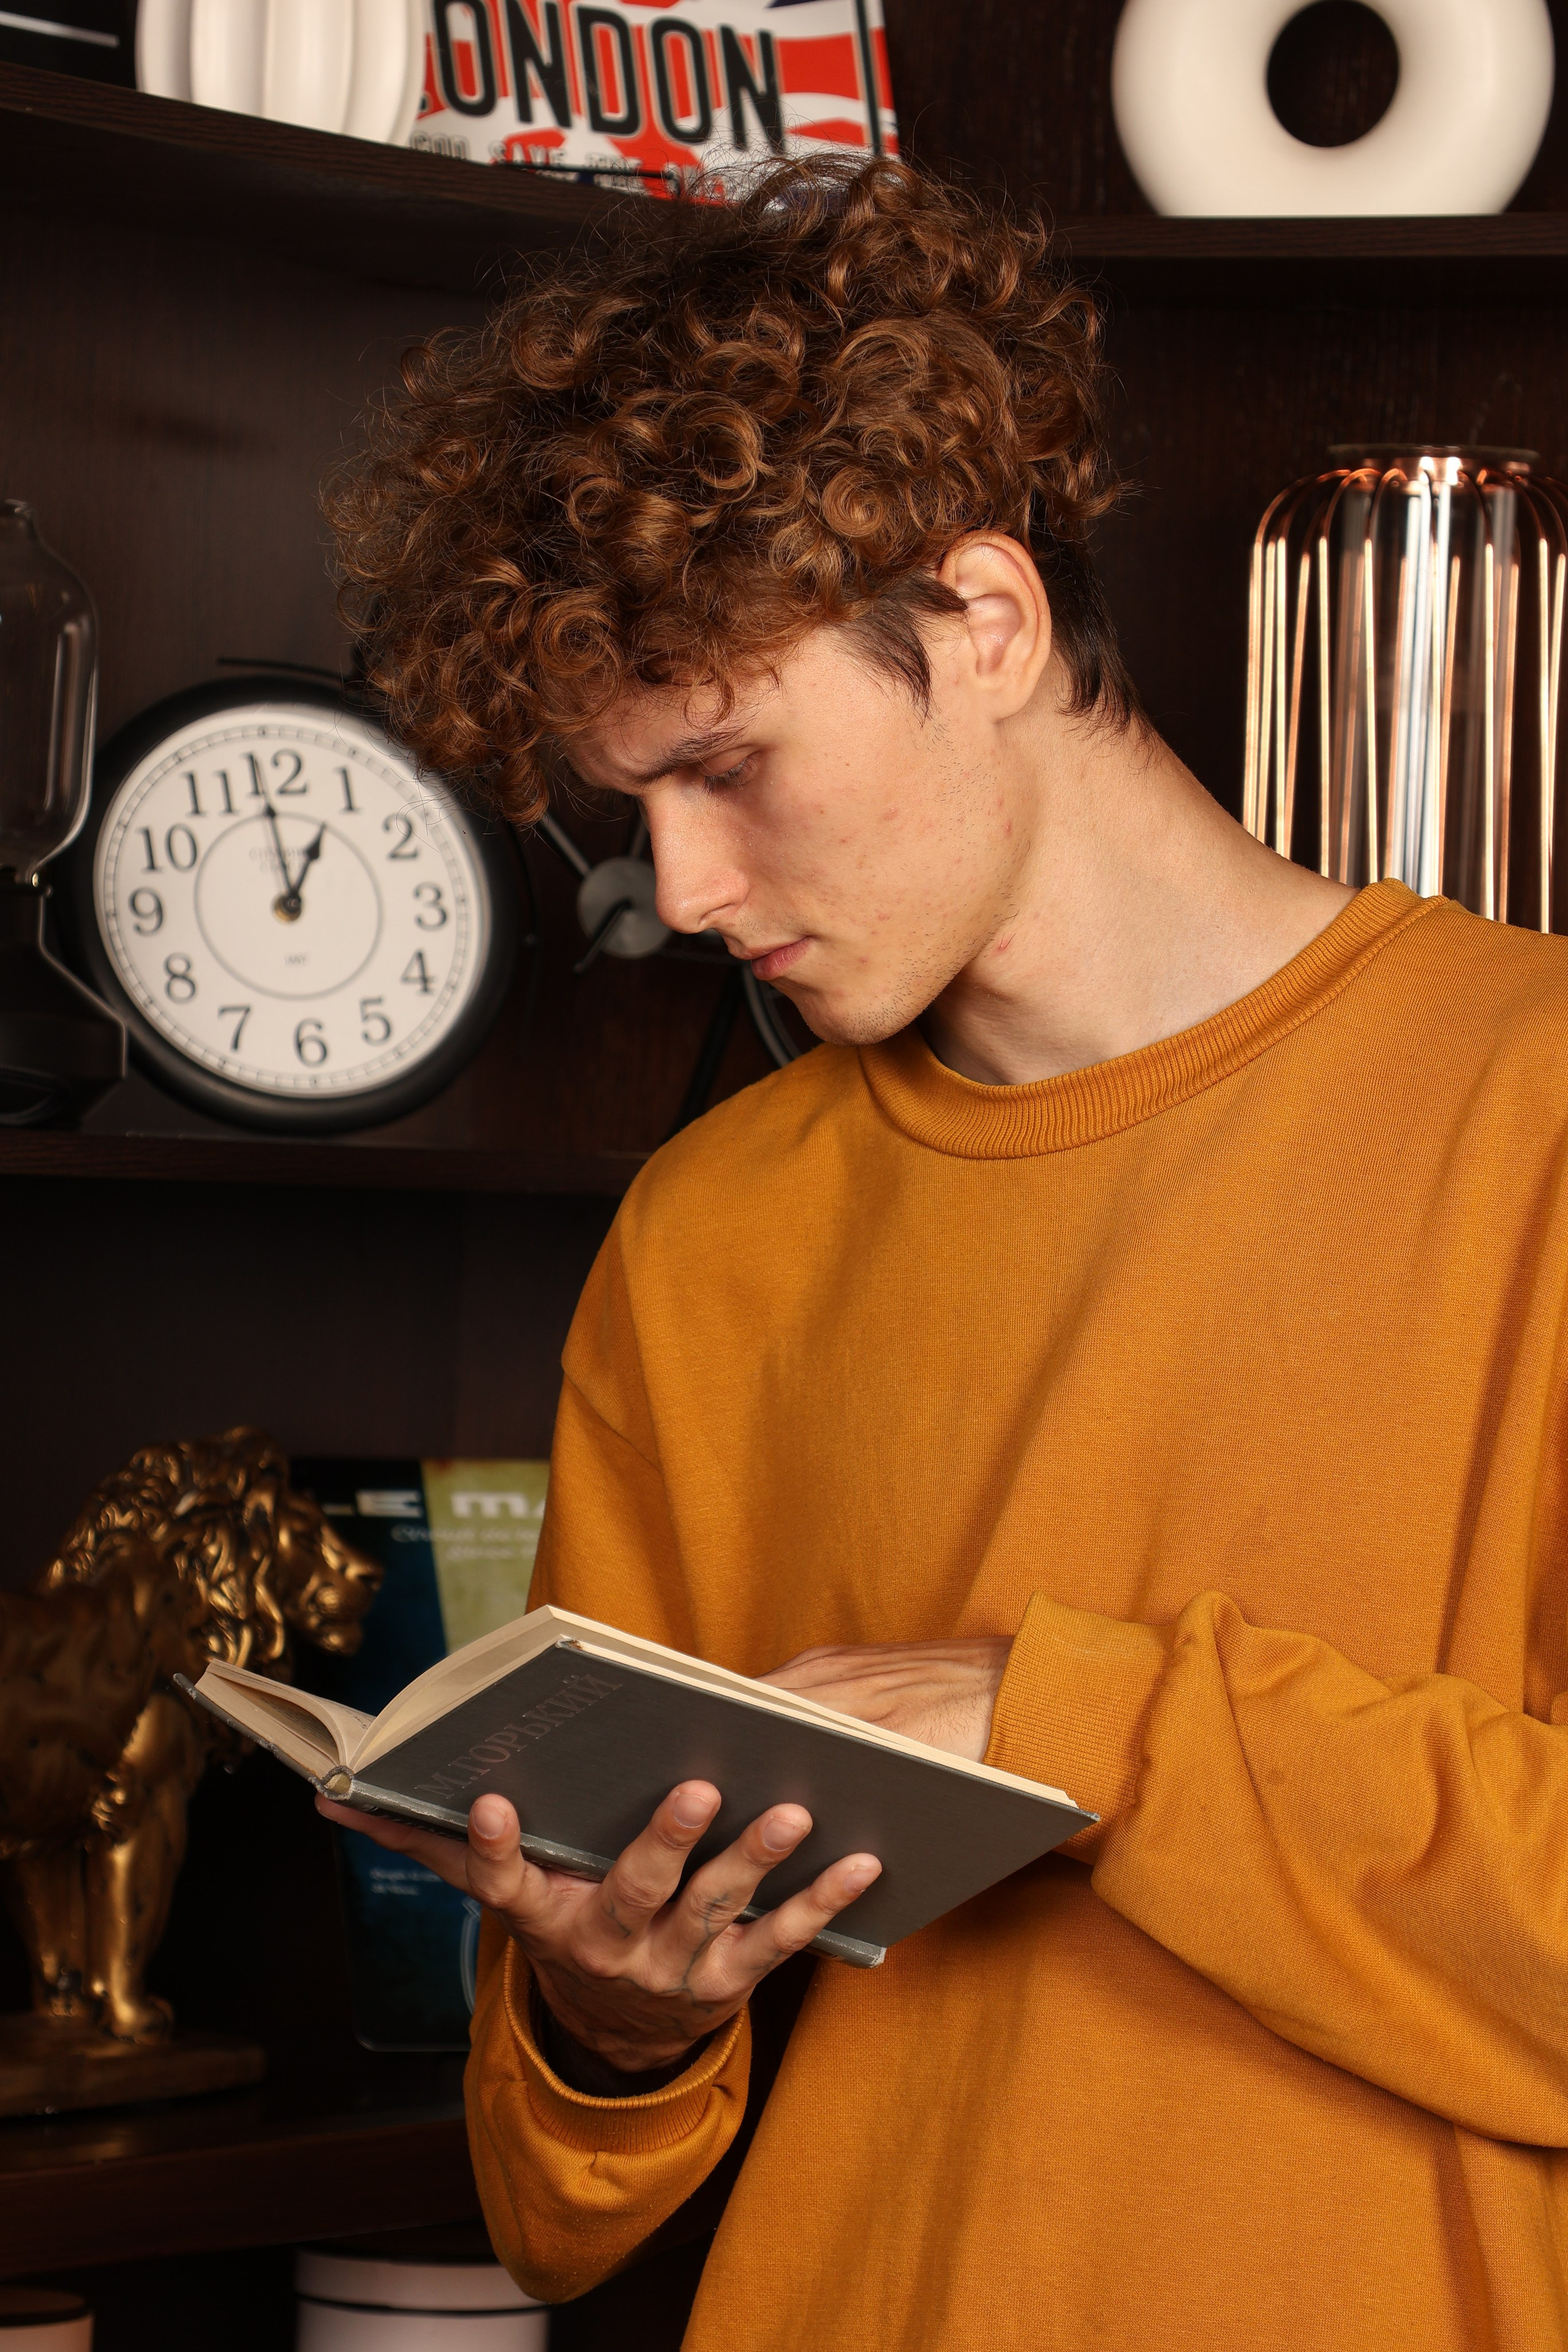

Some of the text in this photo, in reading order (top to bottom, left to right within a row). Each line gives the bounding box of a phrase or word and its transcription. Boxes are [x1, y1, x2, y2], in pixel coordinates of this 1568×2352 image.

[420, 0, 786, 153] ONDON
[183, 769, 238, 817] 11
[243, 749, 309, 799] 12
[334, 765, 360, 815] 1
[138, 824, 199, 874] 10
[382, 812, 421, 861] 2
[126, 886, 165, 937] 9
[412, 881, 450, 931] 3
[162, 952, 197, 1003] 8
[400, 948, 435, 997] 4
[217, 1003, 253, 1053] 7
[292, 1018, 330, 1069] 6
[358, 995, 393, 1046] 5
